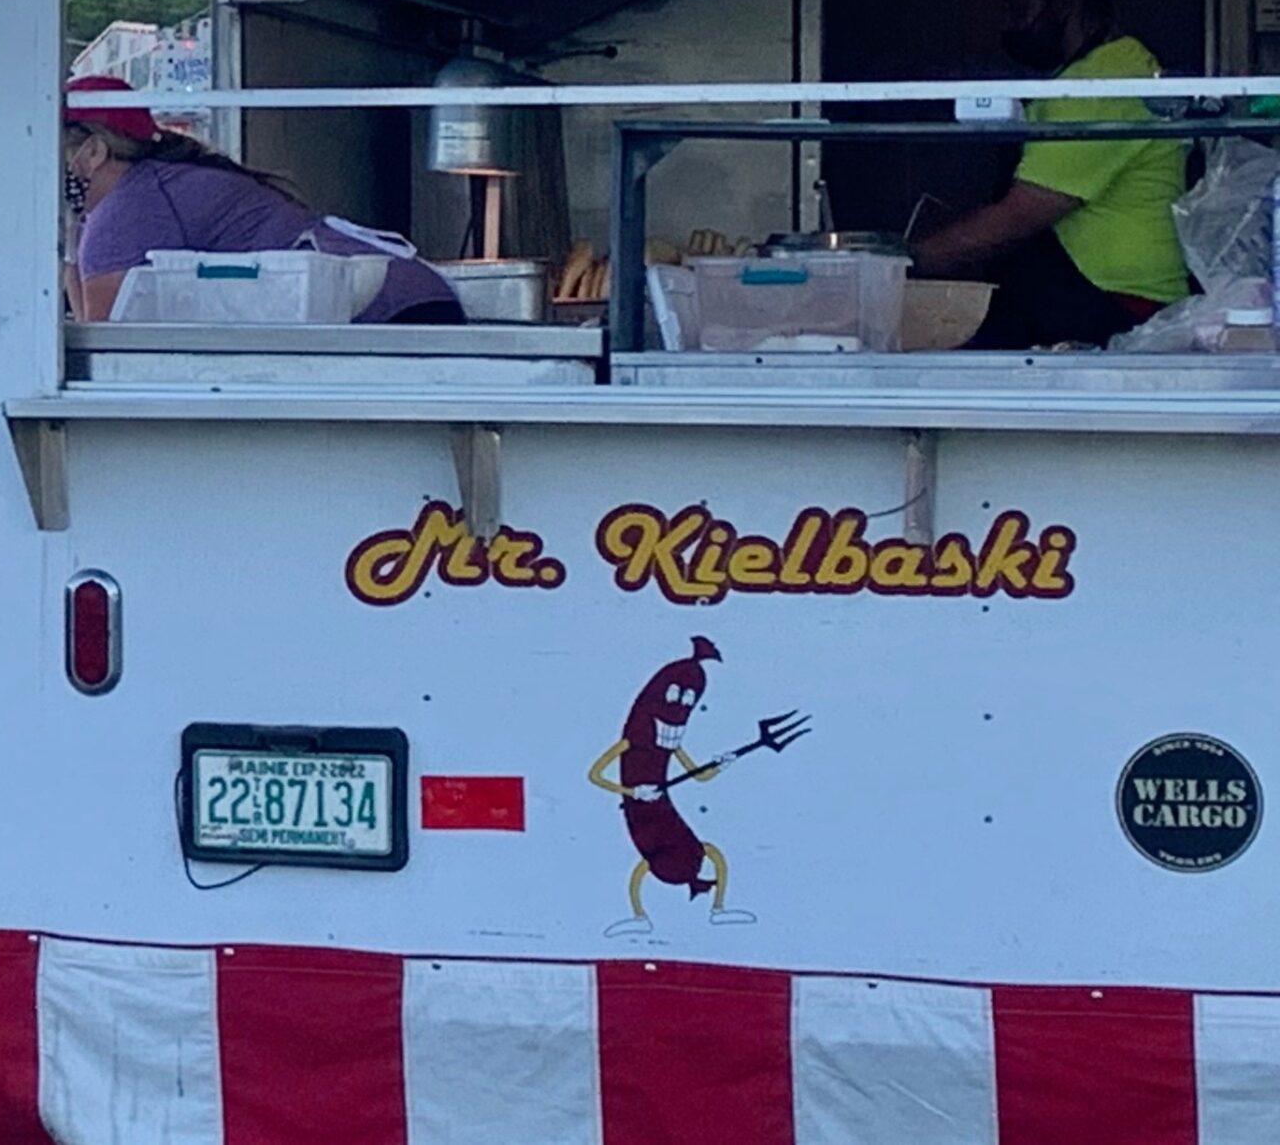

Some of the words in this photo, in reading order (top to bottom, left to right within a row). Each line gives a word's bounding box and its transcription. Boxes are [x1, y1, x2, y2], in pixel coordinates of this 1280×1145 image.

[345, 501, 566, 606] Mr.
[596, 502, 1077, 606] Kielbaski
[228, 758, 290, 776] MAINE
[1132, 777, 1248, 802] WELLS
[1132, 803, 1248, 828] CARGO
